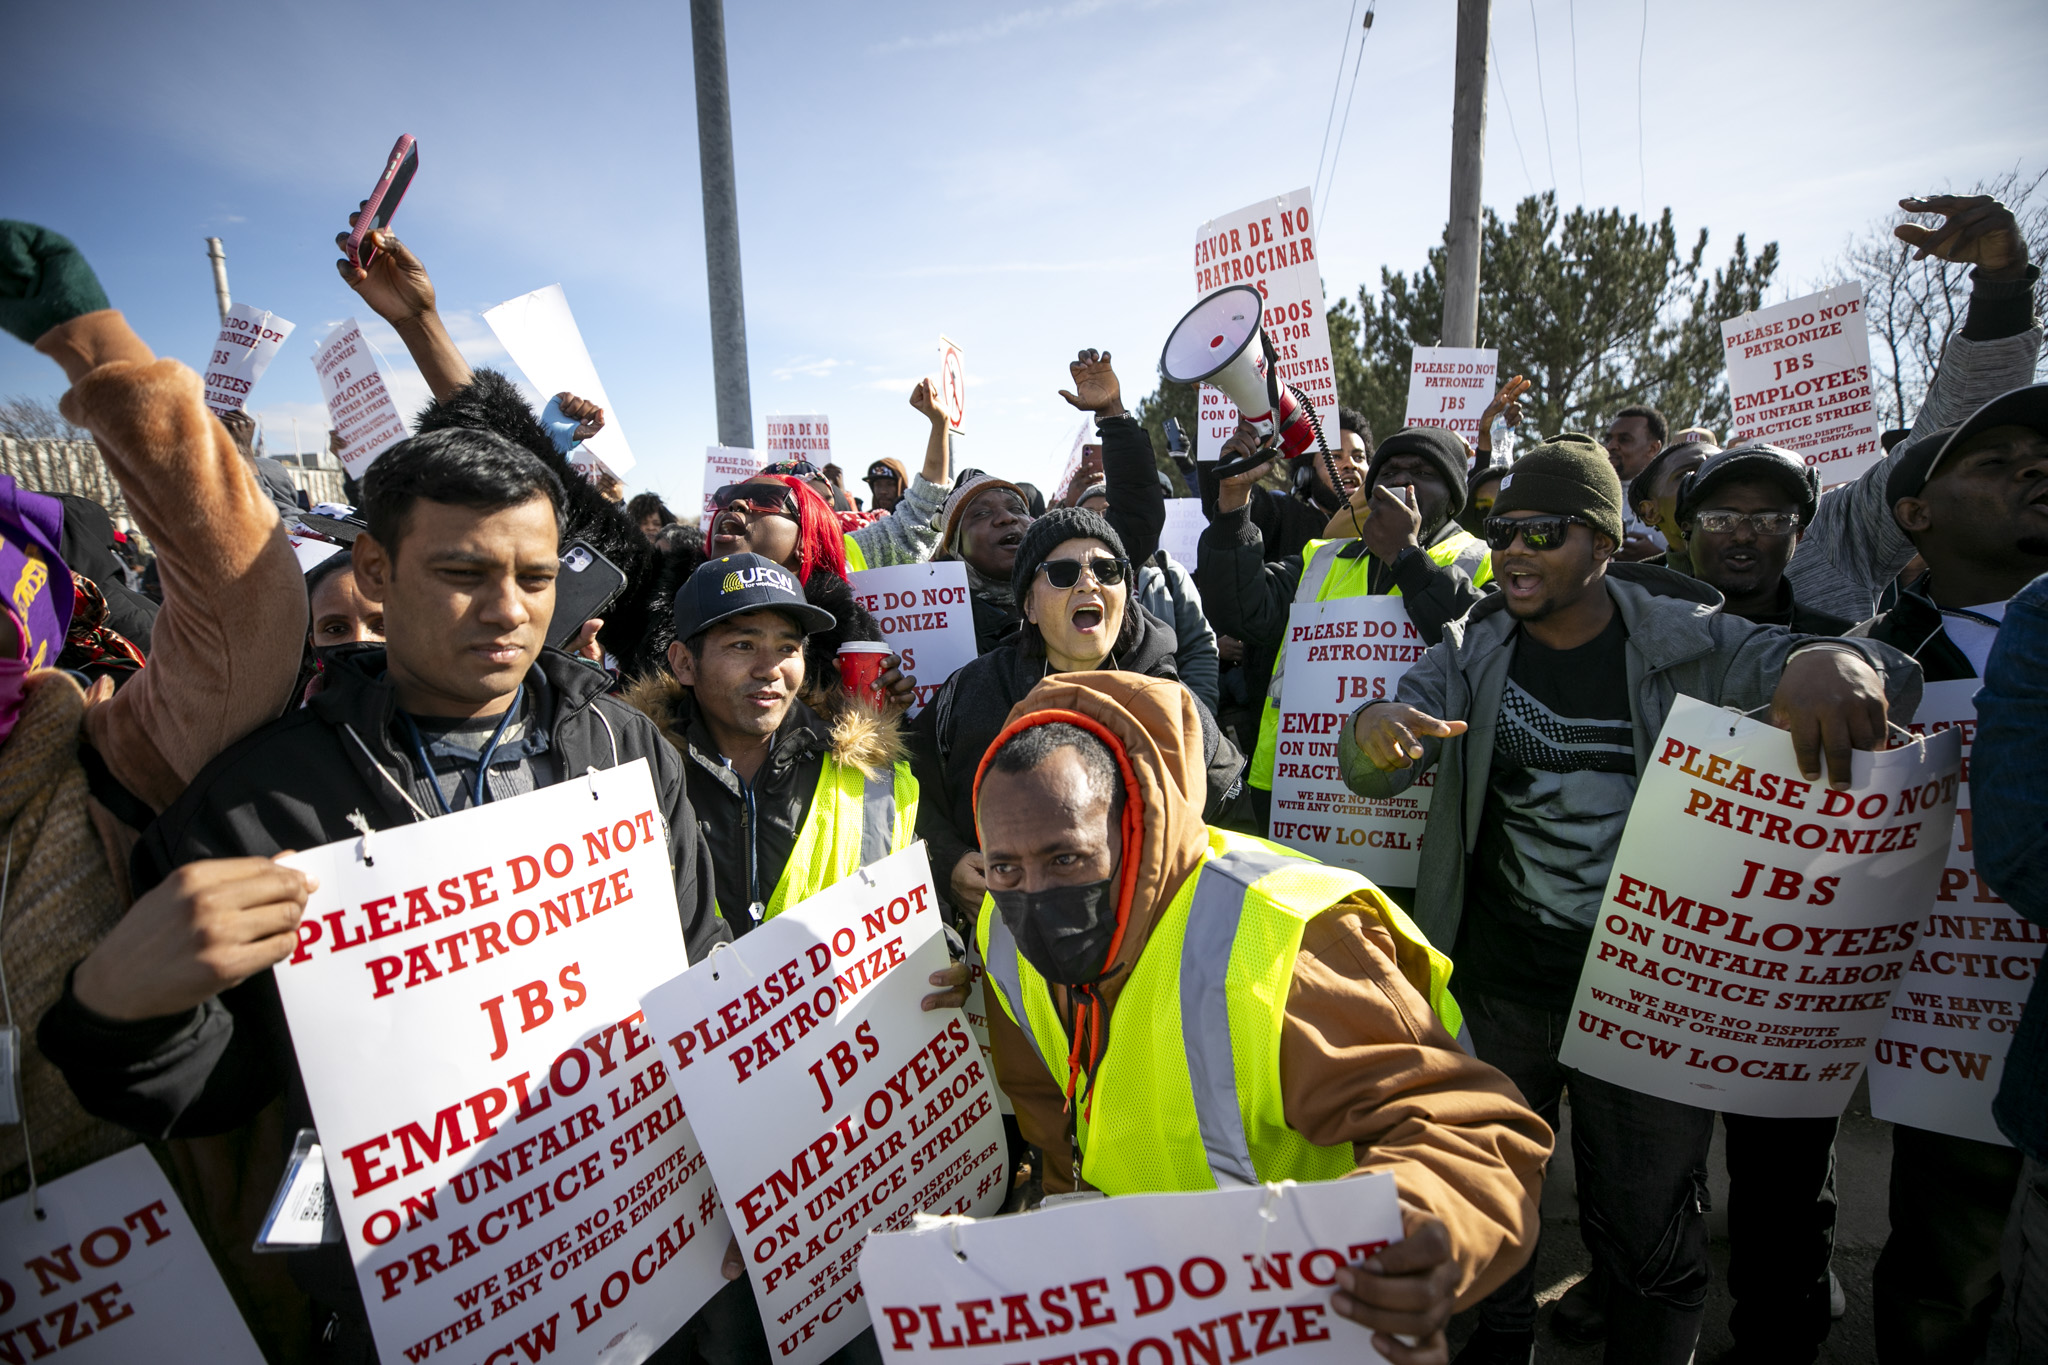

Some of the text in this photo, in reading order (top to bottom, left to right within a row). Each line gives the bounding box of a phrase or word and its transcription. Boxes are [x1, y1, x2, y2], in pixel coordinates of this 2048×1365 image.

[1195, 206, 1310, 267] FAVOR DE NO
[1196, 237, 1315, 293] PRATROCINAR
[249, 324, 284, 343] NOT
[341, 328, 361, 345] NOT
[1284, 322, 1311, 342] POR
[1726, 299, 1860, 348] PLEASE DO NOT
[1744, 322, 1842, 359] PATRONIZE
[210, 350, 231, 365] BS
[1414, 362, 1496, 375] PLEASE DO NOT
[1774, 353, 1814, 380] JBS
[333, 367, 353, 389] JBS
[360, 384, 387, 404] LABOR
[1425, 377, 1485, 389] PATRONIZE
[1734, 365, 1868, 411] EMPLOYEES
[364, 395, 391, 415] STRIKE
[1201, 410, 1225, 421] CON
[1202, 394, 1218, 405] NO
[1440, 396, 1466, 413] JBS
[1736, 385, 1871, 426] ON UNFAIR LABOR
[767, 423, 829, 436] FAVOR DE NO
[1738, 401, 1872, 440] PRACTICE STRIKE
[1773, 424, 1854, 447] HAVE NO DISPUTE
[1821, 426, 1872, 444] EMPLOYER
[342, 444, 366, 463] UFCW
[366, 430, 394, 450] LOCAL
[707, 456, 754, 467] PLEASE DO
[767, 438, 830, 450] PRATROCINAR
[1805, 440, 1876, 466] OCAL #7
[724, 583, 745, 593] VOICE
[735, 566, 793, 590] UFCW
[883, 590, 917, 611] DO
[922, 587, 966, 607] NOT
[880, 611, 948, 635] ONIZE
[1291, 621, 1358, 642] PLEASE
[1363, 621, 1397, 638] DO
[1307, 644, 1426, 663] PATRONIZE
[1336, 676, 1386, 704] JBS
[1279, 741, 1304, 756] ON
[1658, 737, 1957, 820] PLEASE DO NOT
[1278, 800, 1372, 816] WITH ANY OTHER
[1297, 790, 1418, 809] WE HAVE NO DISPUTE
[1273, 821, 1411, 850] UFCW LOCAL
[1684, 788, 1922, 855] PATRONIZE
[289, 809, 655, 967] PLEASE DO NOT
[1731, 859, 1841, 906] JBS
[365, 868, 634, 1000] PATRONIZE
[1612, 873, 1920, 957] EMPLOYEES
[1605, 914, 1904, 985] ON UNFAIR LABOR
[668, 883, 929, 1071] PLEASE DO NOT
[1597, 941, 1891, 1013] PRACTICE STRIKE
[480, 961, 588, 1062] JBS
[728, 936, 907, 1084] PATRONIZE
[1590, 987, 1868, 1050] WITH ANY OTHER EMPLOYER
[1629, 988, 1840, 1038] WE HAVE NO DISPUTE
[1891, 1006, 1928, 1024] ITH
[1933, 1012, 1981, 1031] ANY
[1907, 991, 2013, 1016] WE HAVE
[1578, 1009, 1861, 1082] UFCW LOCAL #7
[1874, 1038, 1993, 1082] UFCW
[808, 1019, 881, 1114] JBS
[341, 1009, 656, 1199] EMPLOYE
[735, 1018, 970, 1236] EMPLOYEES
[362, 1060, 670, 1246] ON UNFAIR LAB
[753, 1060, 985, 1264] ON UNFAIR LABOR
[375, 1093, 686, 1302] PRACTICE STRI
[762, 1091, 993, 1295] PRACTICE STRIKE
[453, 1145, 687, 1311] WE HAVE NO DISPUTE
[777, 1286, 827, 1326] WITH
[922, 1142, 999, 1211] EMPLOYER
[808, 1260, 838, 1287] WE
[885, 1202, 910, 1229] NO
[912, 1149, 973, 1203] DISPUTE
[24, 1199, 172, 1297] NOT
[777, 1163, 1004, 1357] UFCW #7
[402, 1309, 485, 1365] WITH
[490, 1273, 543, 1321] ANY
[550, 1219, 628, 1280] OTHER
[571, 1214, 696, 1333] LOCAL
[883, 1278, 1117, 1352] PLEASE
[1125, 1256, 1228, 1317] DO
